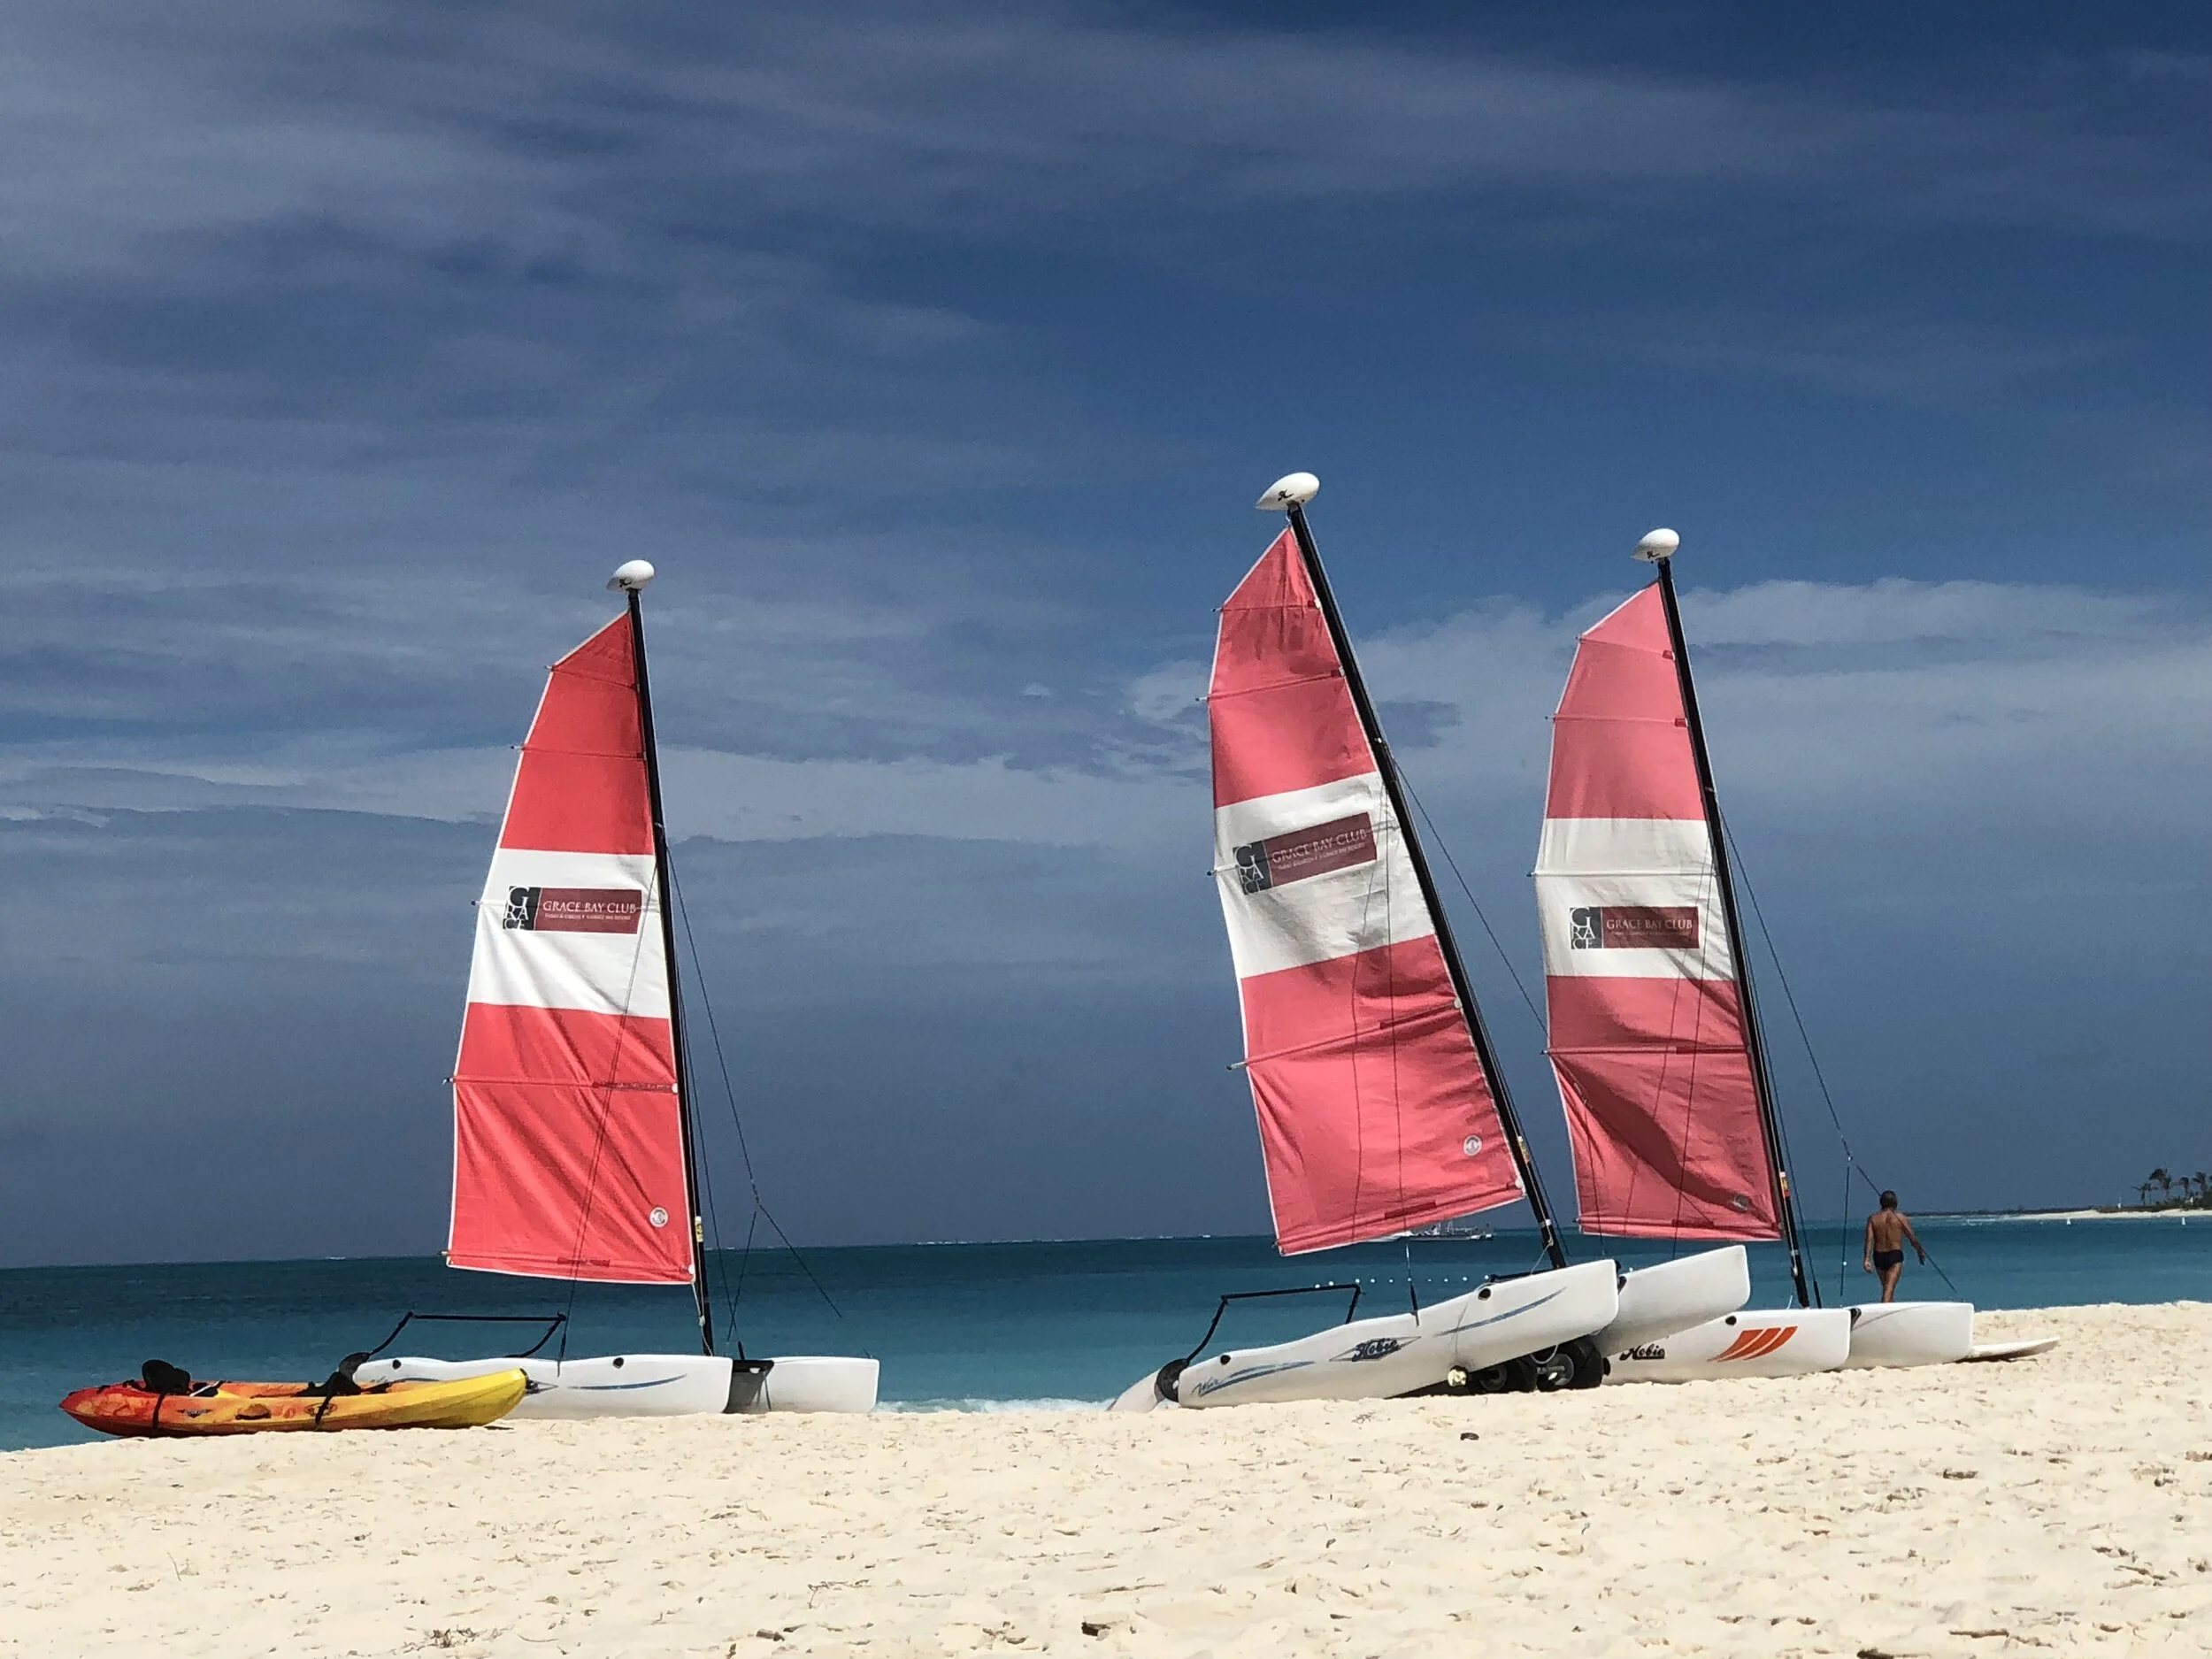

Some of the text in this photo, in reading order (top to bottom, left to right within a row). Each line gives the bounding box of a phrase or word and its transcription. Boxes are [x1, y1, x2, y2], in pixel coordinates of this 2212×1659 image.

[1271, 842, 1310, 864] GRACE
[1313, 837, 1335, 854] BAY
[1336, 828, 1368, 845] CLUB
[542, 900, 636, 914] GRACE BAY CLUB
[1606, 918, 1693, 930] GRACE BAY CLUB
[1619, 1343, 1665, 1361] Hobie
